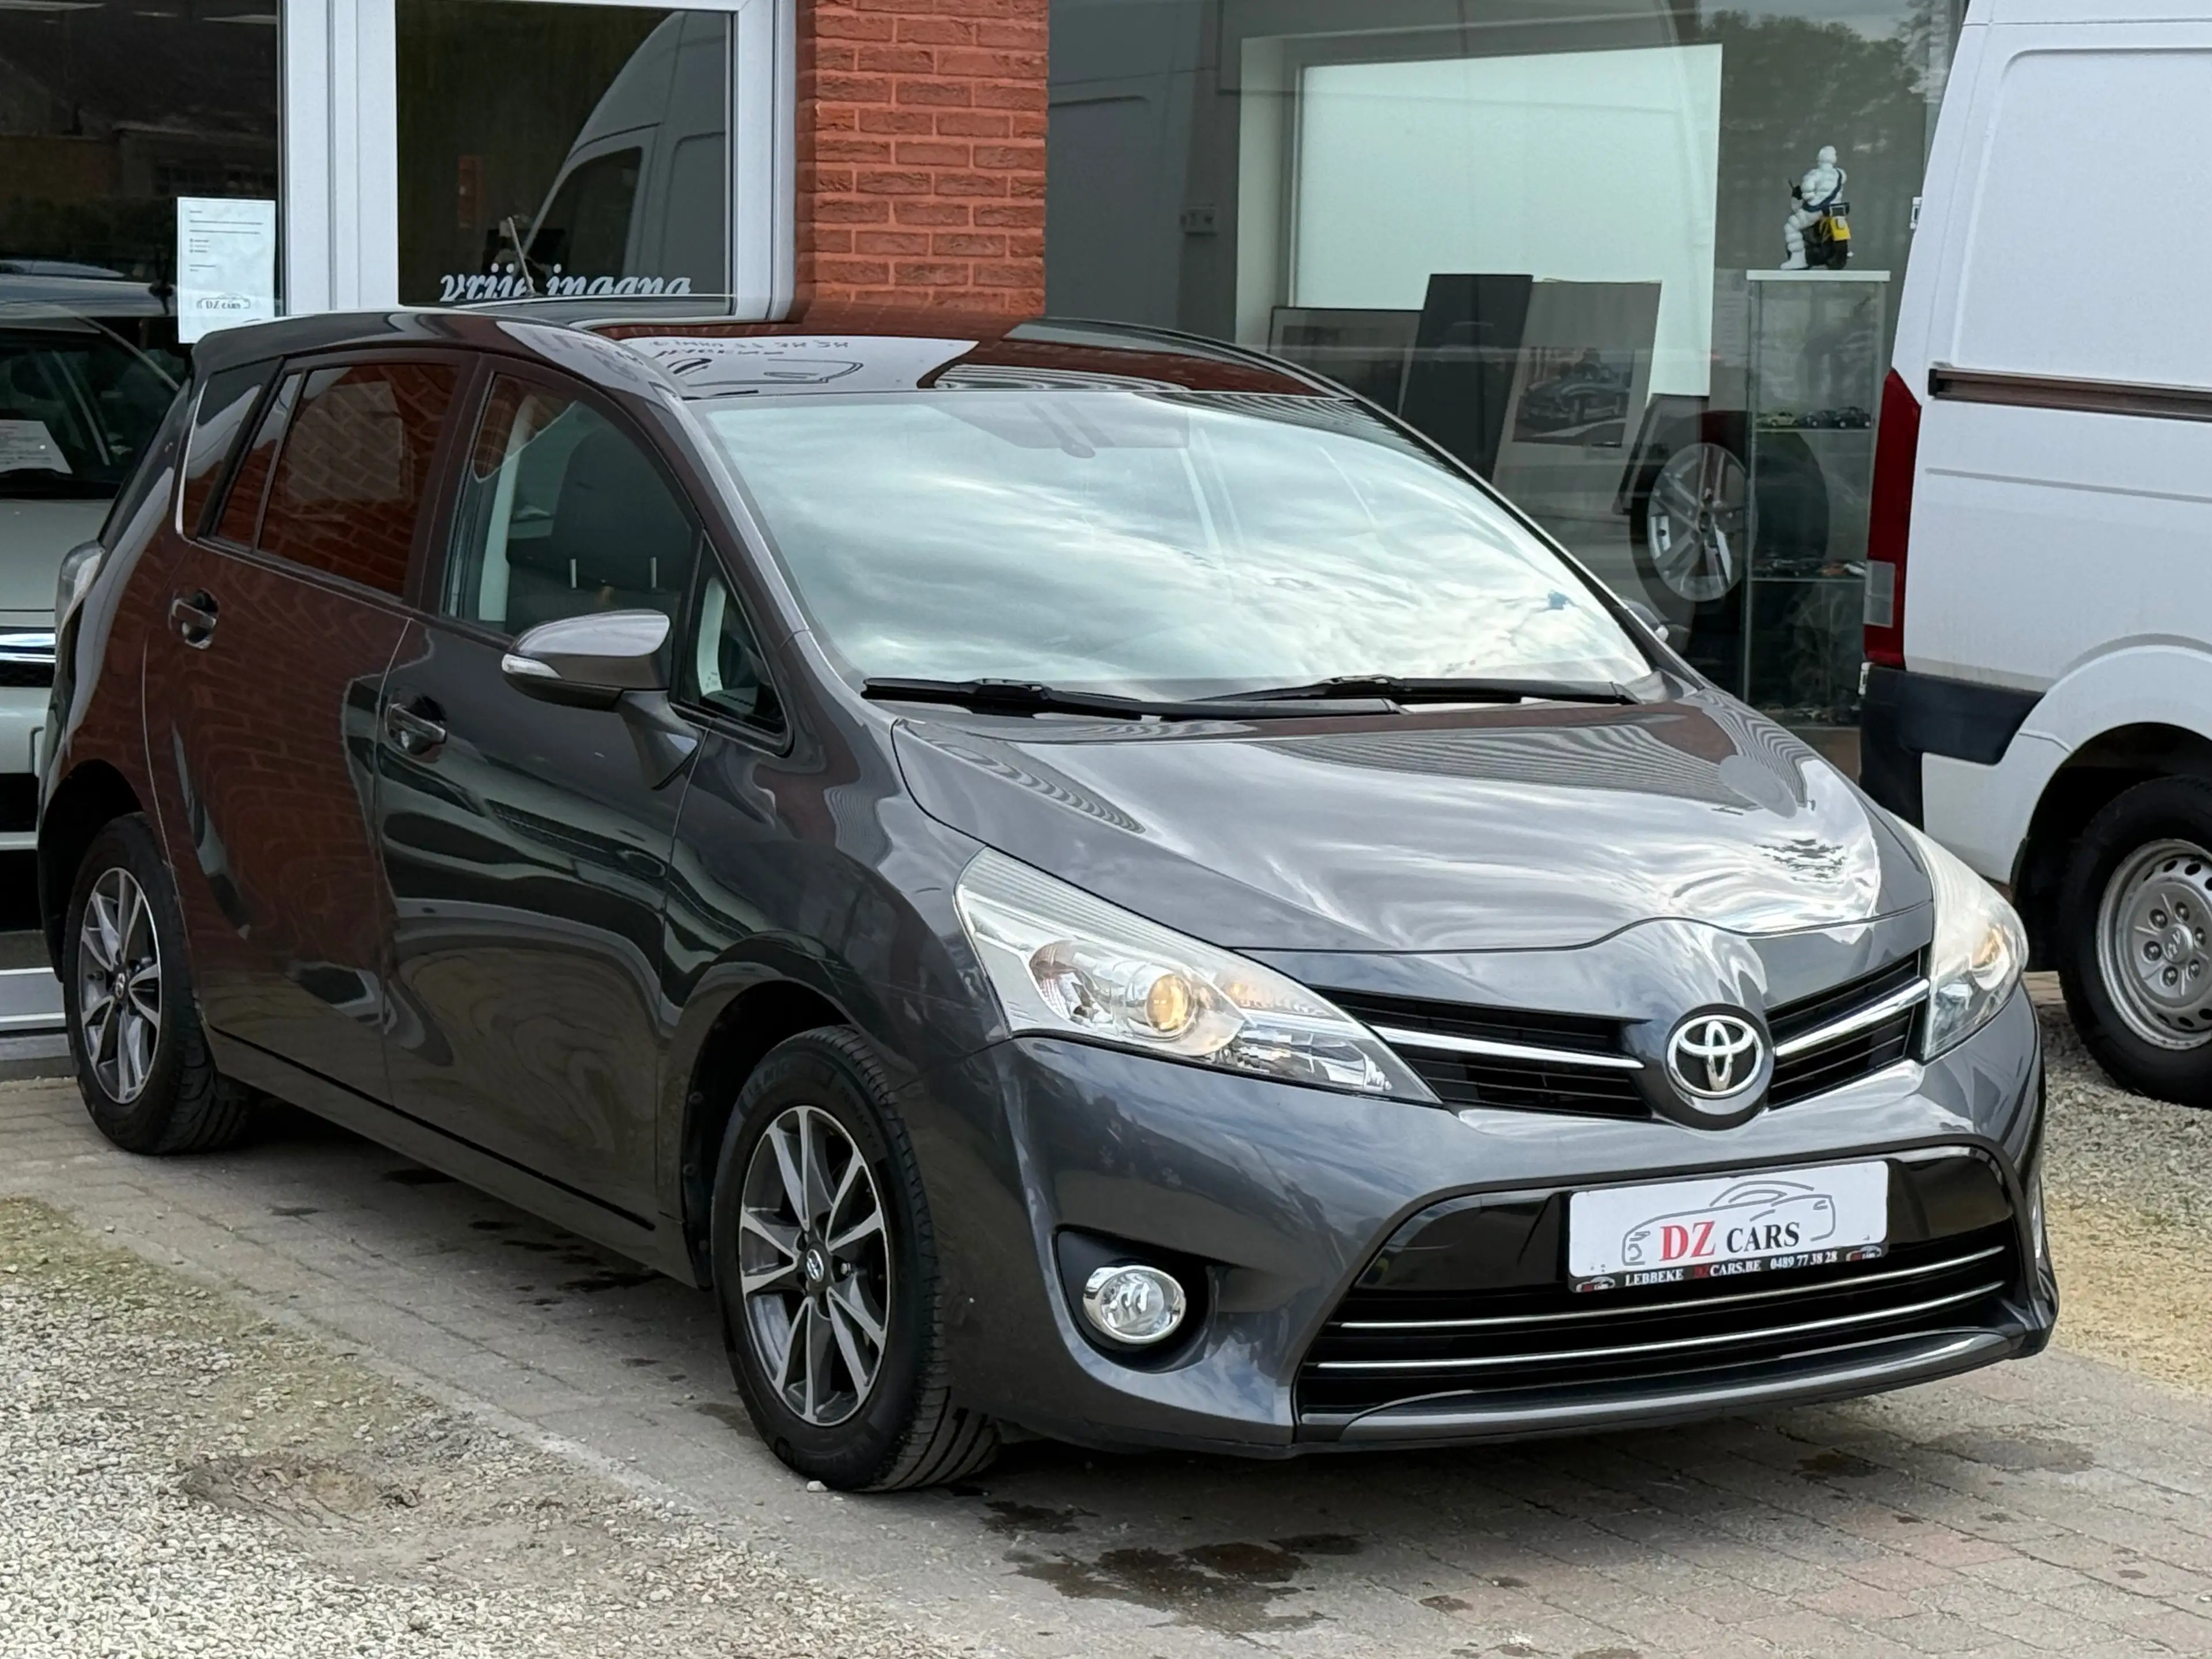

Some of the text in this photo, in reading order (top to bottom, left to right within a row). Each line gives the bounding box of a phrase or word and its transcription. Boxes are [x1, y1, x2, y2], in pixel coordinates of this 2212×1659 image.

[1659, 1221, 1800, 1262] DZ CARS
[1625, 1268, 1684, 1286] LEBBEKE
[1770, 1255, 1794, 1270] 0489
[1797, 1255, 1809, 1267] 77
